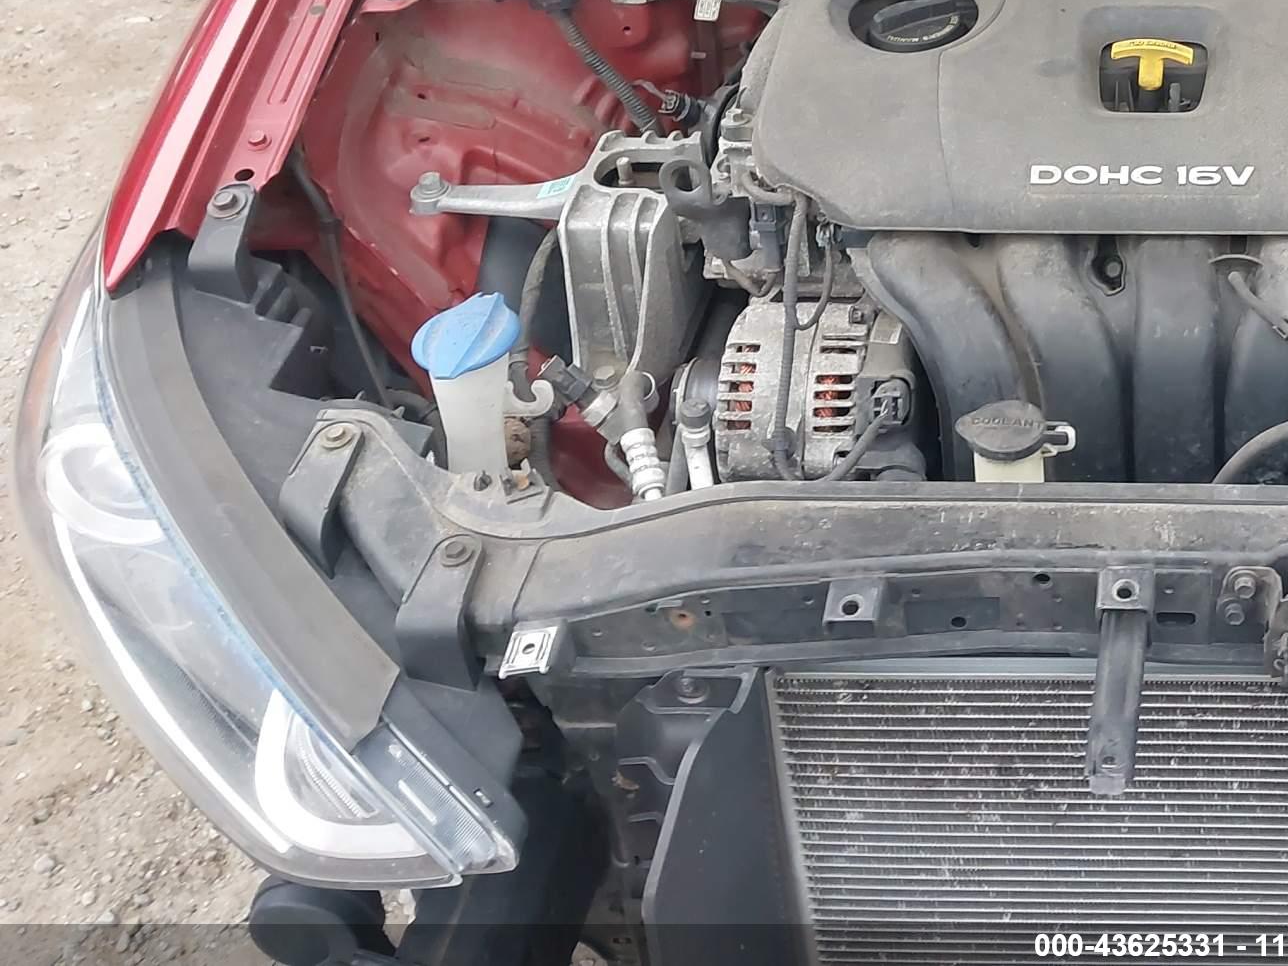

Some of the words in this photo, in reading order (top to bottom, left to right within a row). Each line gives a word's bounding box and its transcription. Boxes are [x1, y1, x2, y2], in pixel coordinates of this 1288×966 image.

[1029, 165, 1163, 185] DOHC
[1176, 165, 1255, 186] 16V
[971, 417, 1042, 429] COOLANT
